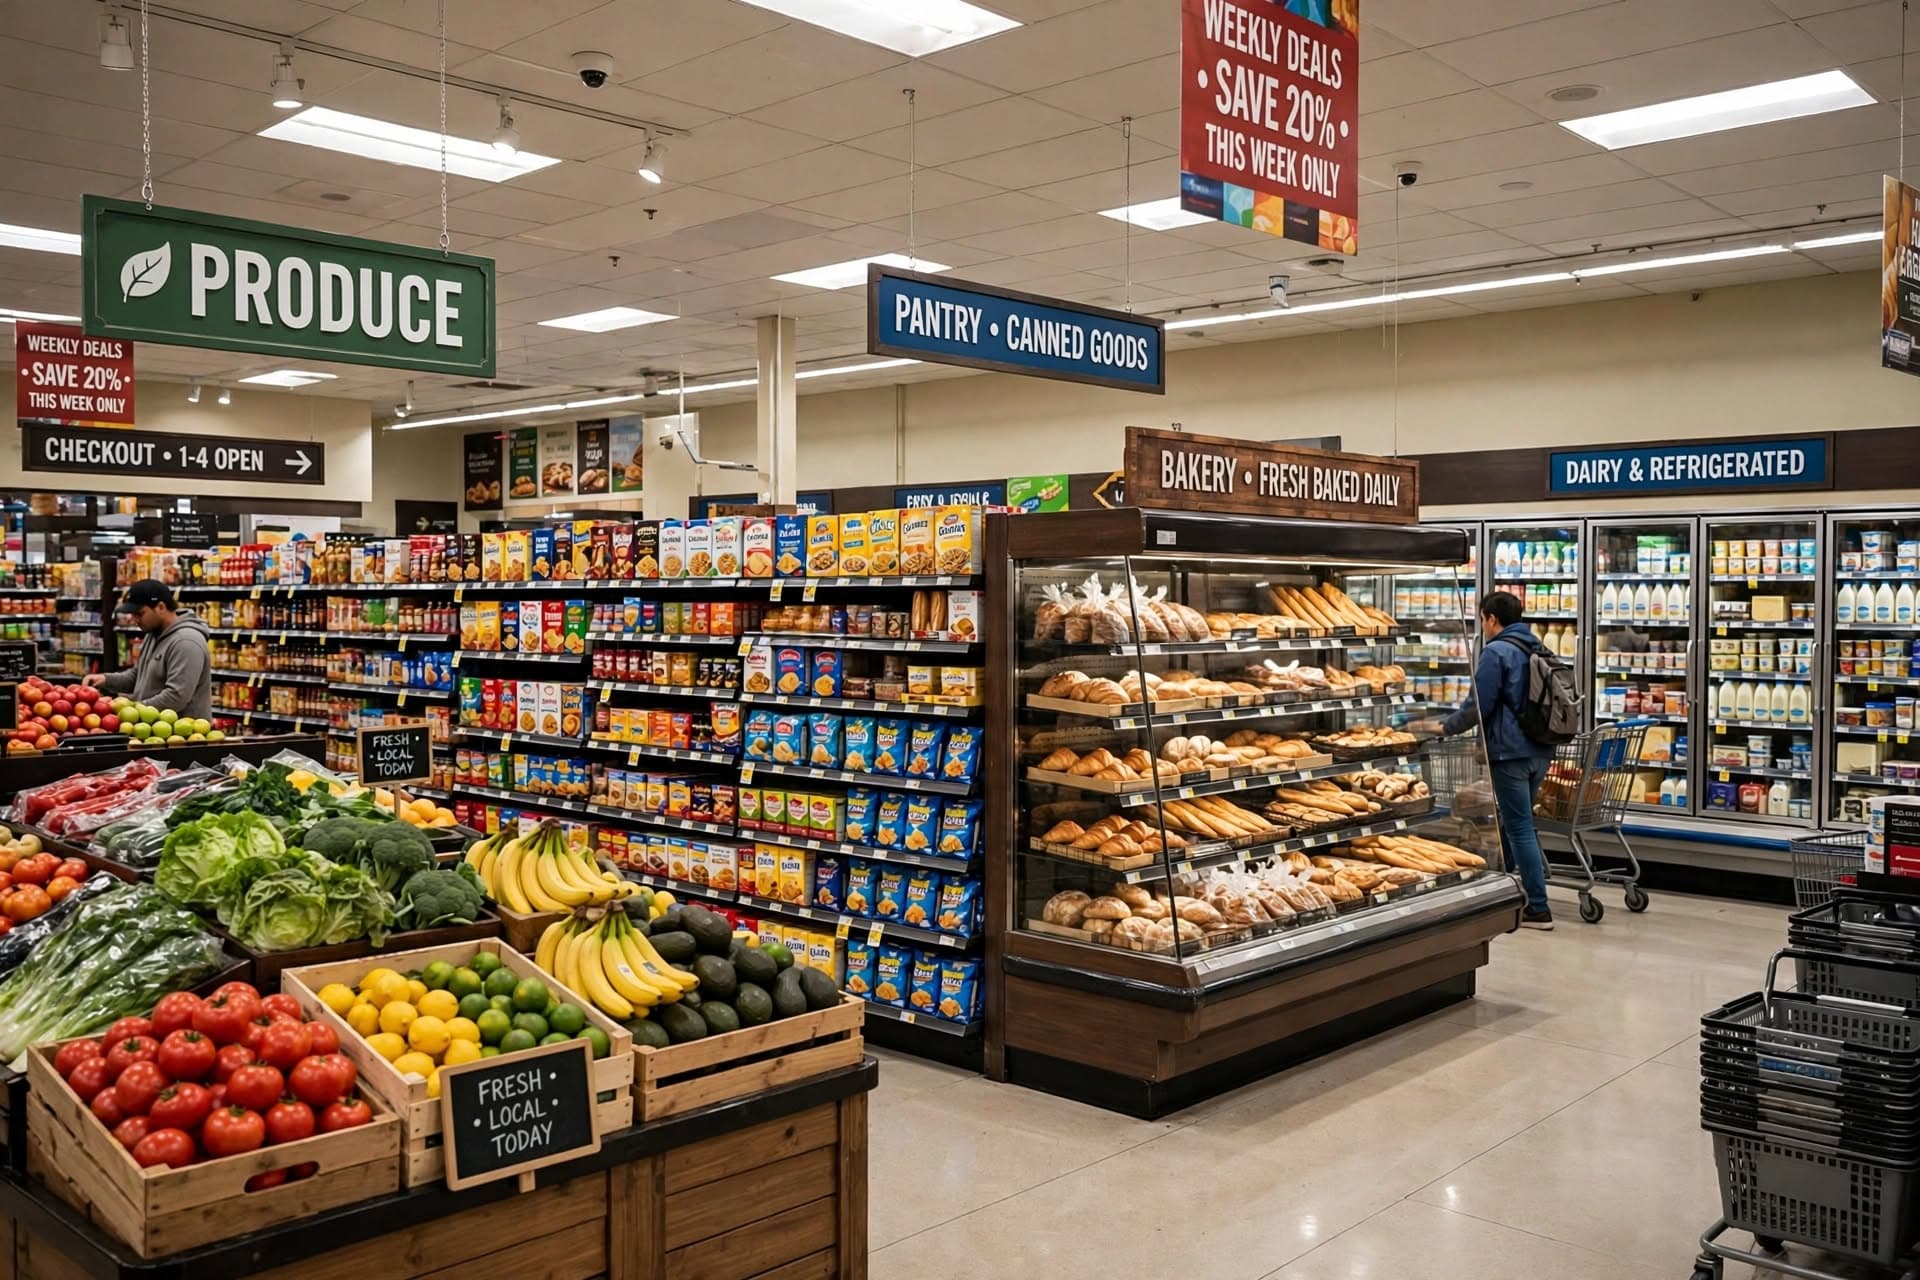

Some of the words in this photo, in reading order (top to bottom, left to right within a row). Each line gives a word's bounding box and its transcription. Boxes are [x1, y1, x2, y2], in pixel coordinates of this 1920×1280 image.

[1204, 0, 1282, 64] WEEKLY
[1287, 29, 1342, 89] DEALS
[1216, 58, 1279, 131] SAVE
[1285, 85, 1335, 150] 20%
[1205, 122, 1245, 171] THIS
[1250, 137, 1298, 187] WEEK
[1302, 154, 1340, 198] ONLY
[190, 242, 463, 348] PRODUCE
[27, 334, 80, 355] WEEKLY
[83, 340, 122, 359] DEALS
[895, 293, 982, 344] PANTRY
[1006, 314, 1085, 360] CANNED
[1090, 328, 1148, 371] GOODS
[32, 361, 79, 388] SAVE
[83, 366, 122, 391] 20%
[28, 392, 56, 409] THIS
[60, 394, 94, 411] WEEK
[96, 397, 126, 414] ONLY
[45, 437, 155, 467] CHECKOUT
[179, 445, 209, 469] 1-4
[214, 447, 264, 472] OPEN
[1566, 458, 1623, 485] DAIRY
[1629, 457, 1644, 482] &
[1650, 449, 1805, 481] REFRIGERATED
[1161, 450, 1238, 494] BAKERY
[1259, 461, 1309, 499] FRESH
[1313, 467, 1360, 503] BAKED
[1364, 471, 1400, 506] DAILY
[373, 733, 409, 748] FRESH
[377, 747, 414, 761] LOCAL
[375, 760, 414, 776] TODAY
[478, 1068, 542, 1105] FRESH
[489, 1098, 547, 1130] LOCAL
[491, 1120, 552, 1157] TODAY
